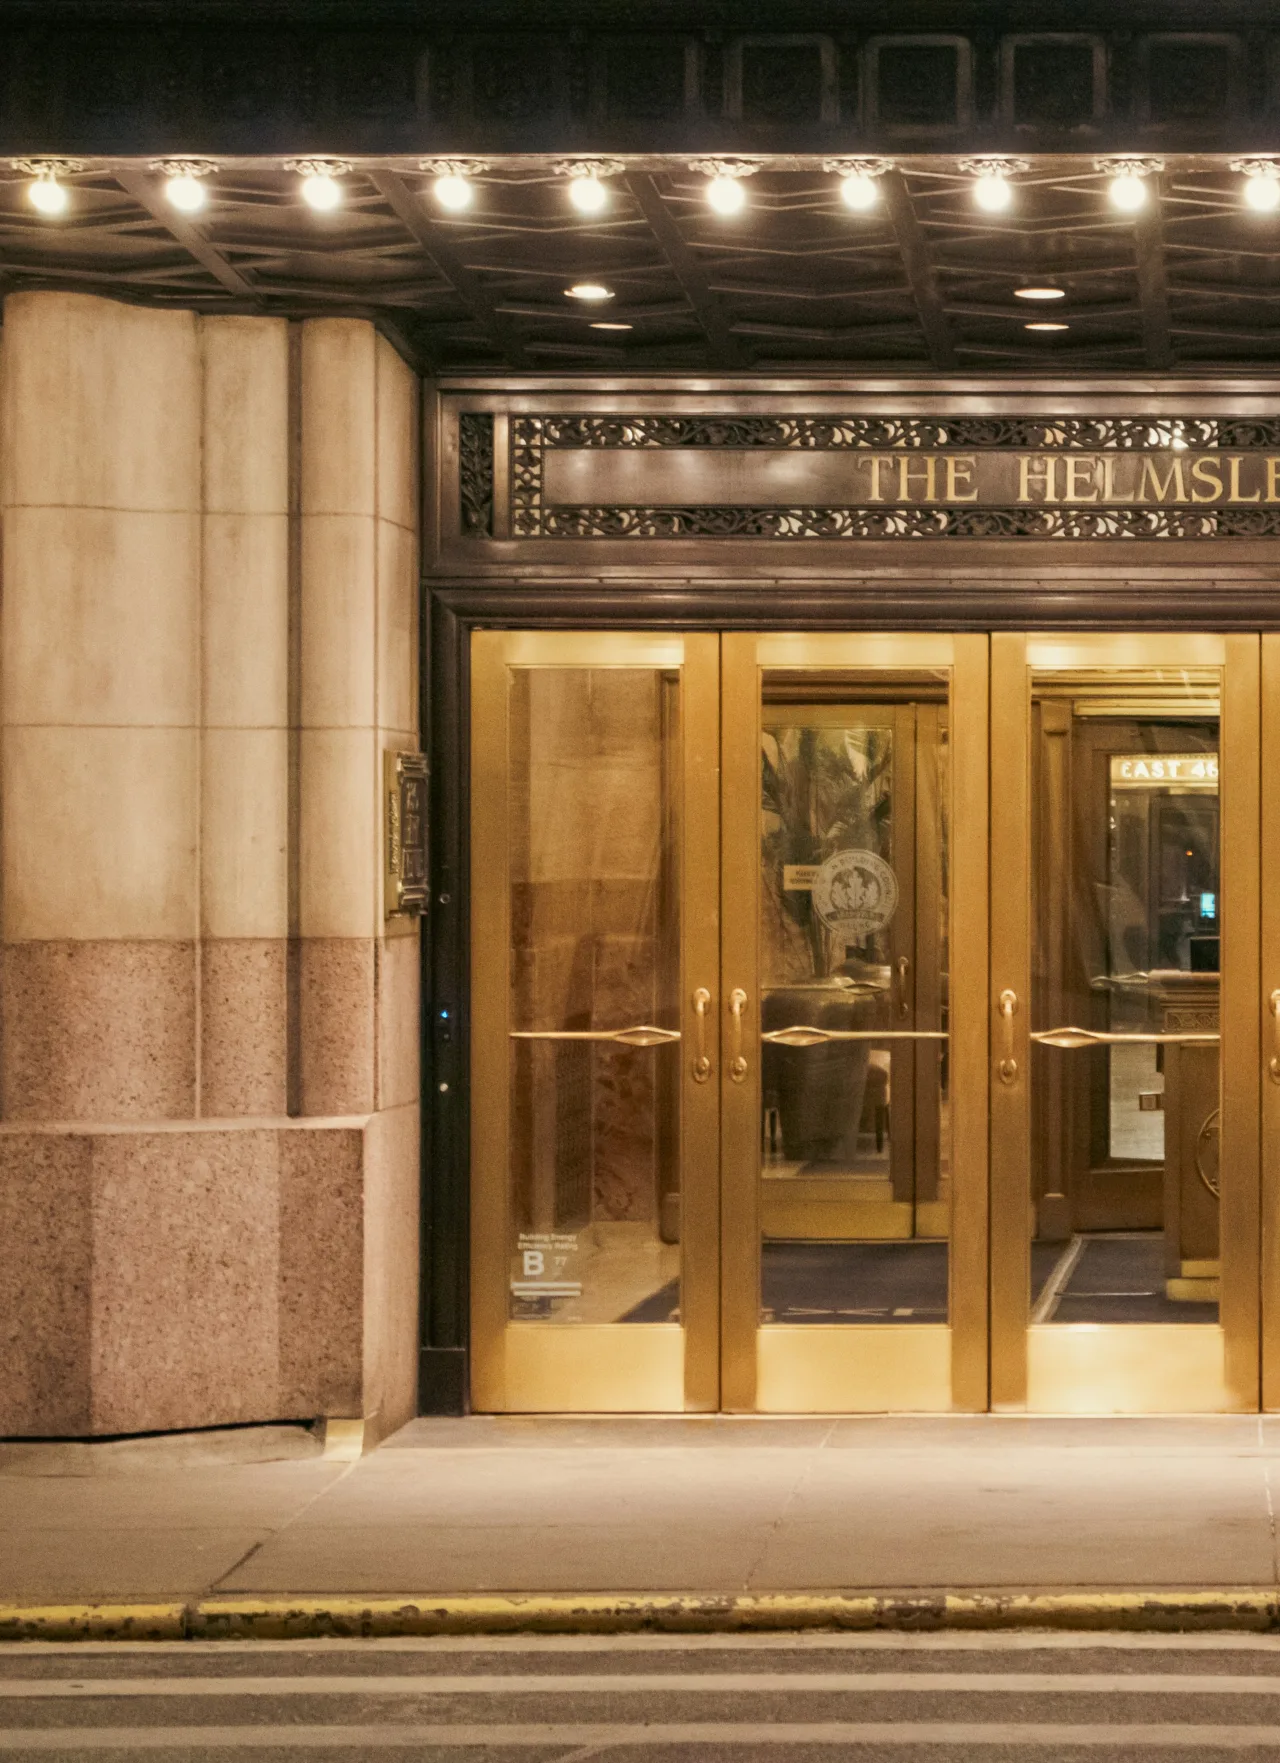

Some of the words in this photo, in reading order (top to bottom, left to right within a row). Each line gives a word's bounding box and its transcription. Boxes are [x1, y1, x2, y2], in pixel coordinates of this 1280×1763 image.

[860, 456, 978, 501] THE
[1120, 760, 1181, 778] EAST
[523, 1251, 545, 1276] B
